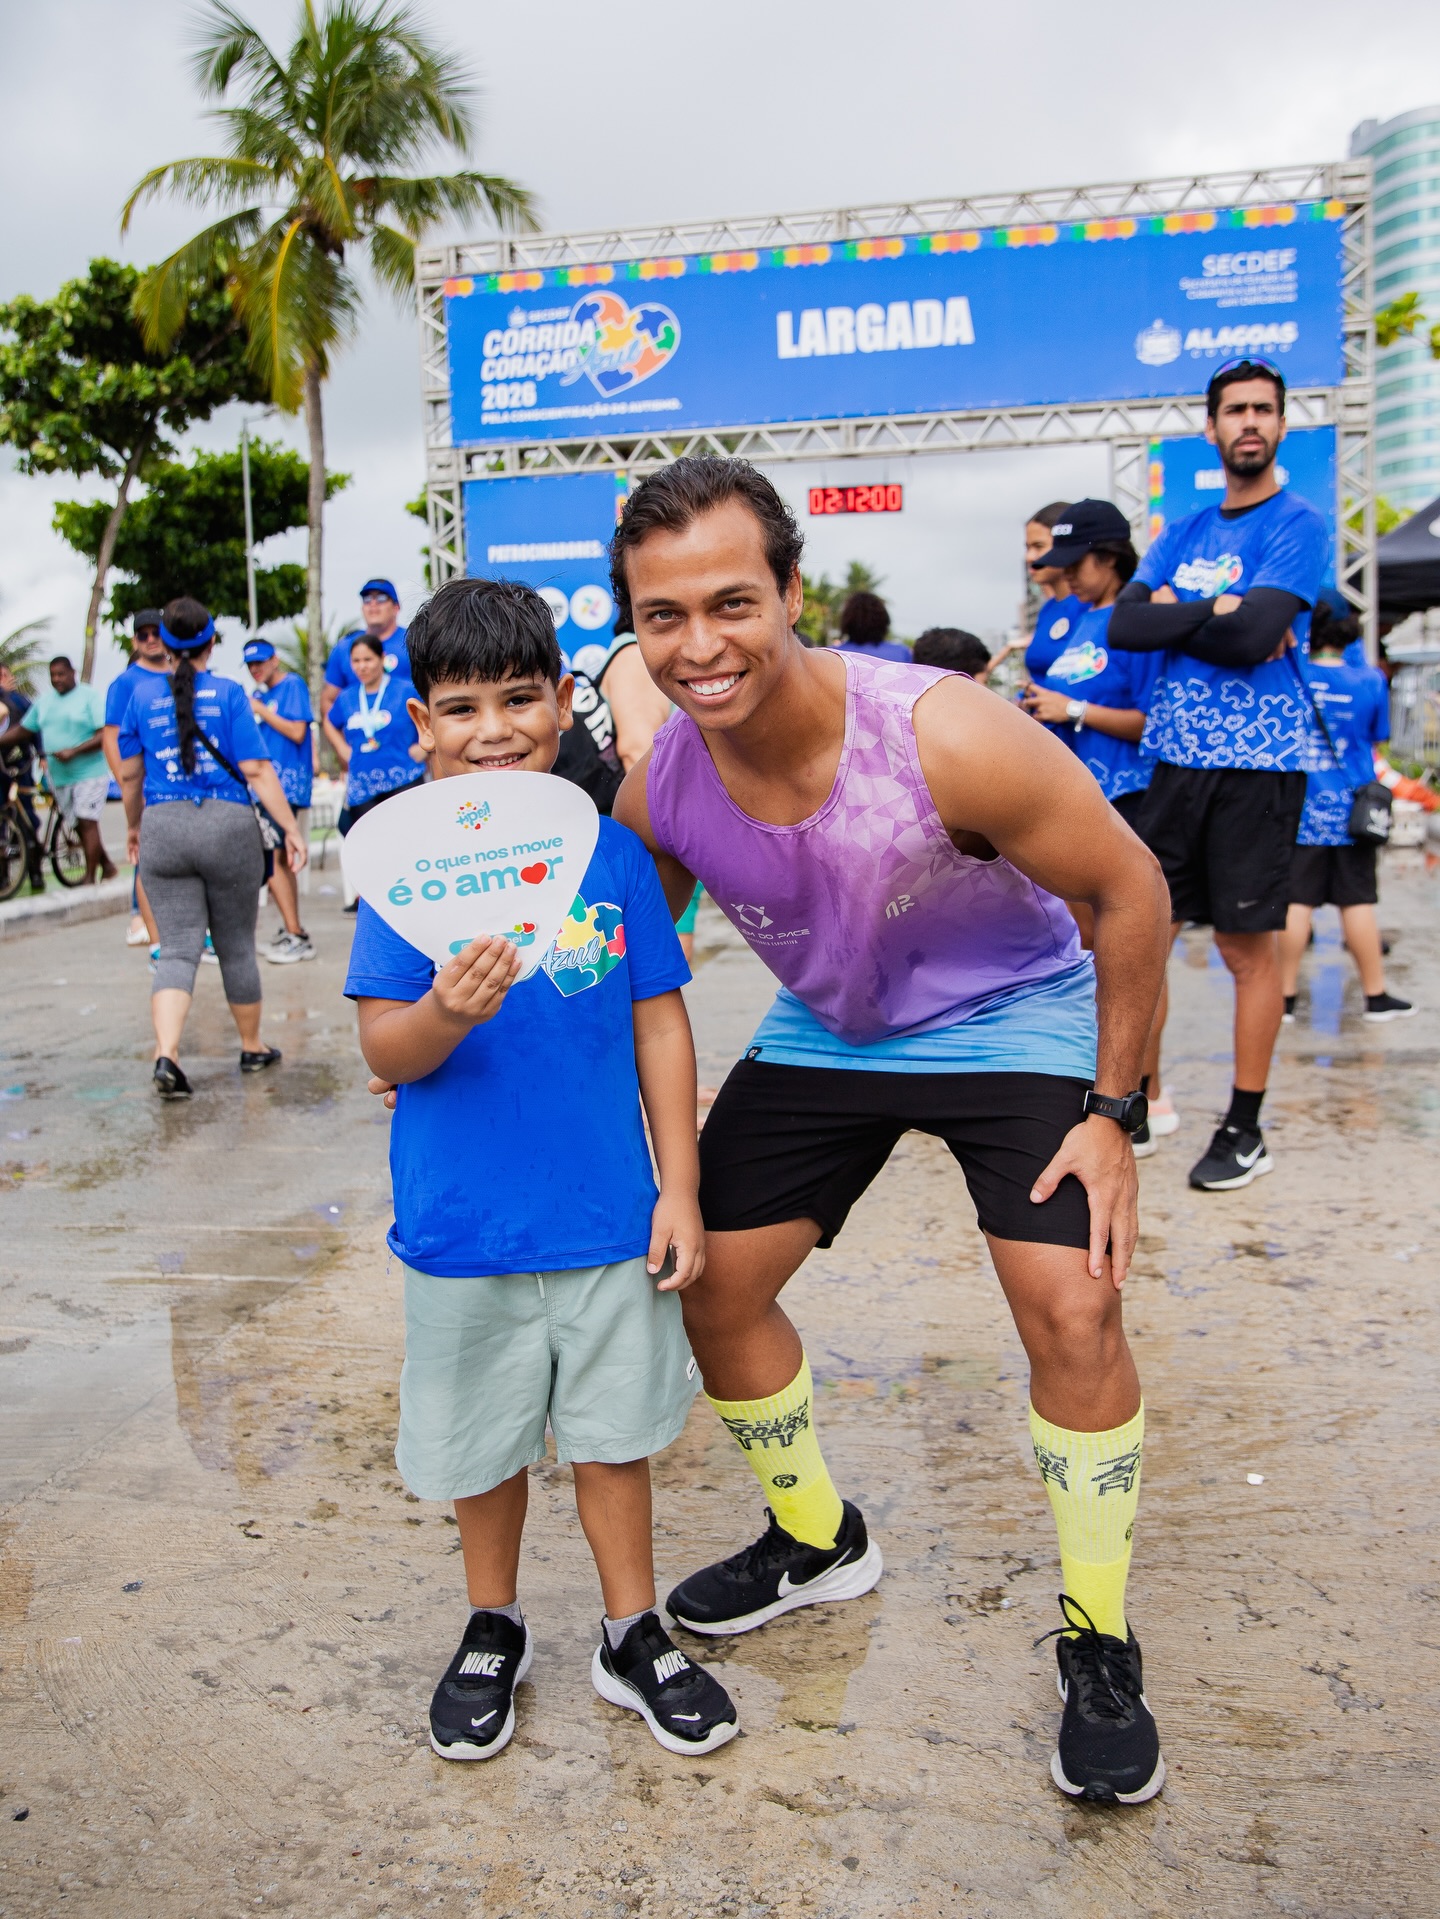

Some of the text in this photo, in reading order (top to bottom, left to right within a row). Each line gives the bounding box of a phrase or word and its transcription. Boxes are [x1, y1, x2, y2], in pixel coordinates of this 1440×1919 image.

[1202, 248, 1298, 277] SECDEF
[483, 319, 597, 358] CORRIDA
[776, 296, 976, 359] LARGADA
[1184, 321, 1299, 350] ALAGOAS
[481, 348, 578, 381] CORAÇÃO
[415, 836, 564, 873] O que nos move
[388, 878, 413, 906] é
[421, 879, 447, 902] o
[777, 928, 811, 939] PACE
[521, 936, 600, 981] Azul
[458, 1652, 506, 1677] NIKE
[653, 1650, 690, 1684] NIKE
